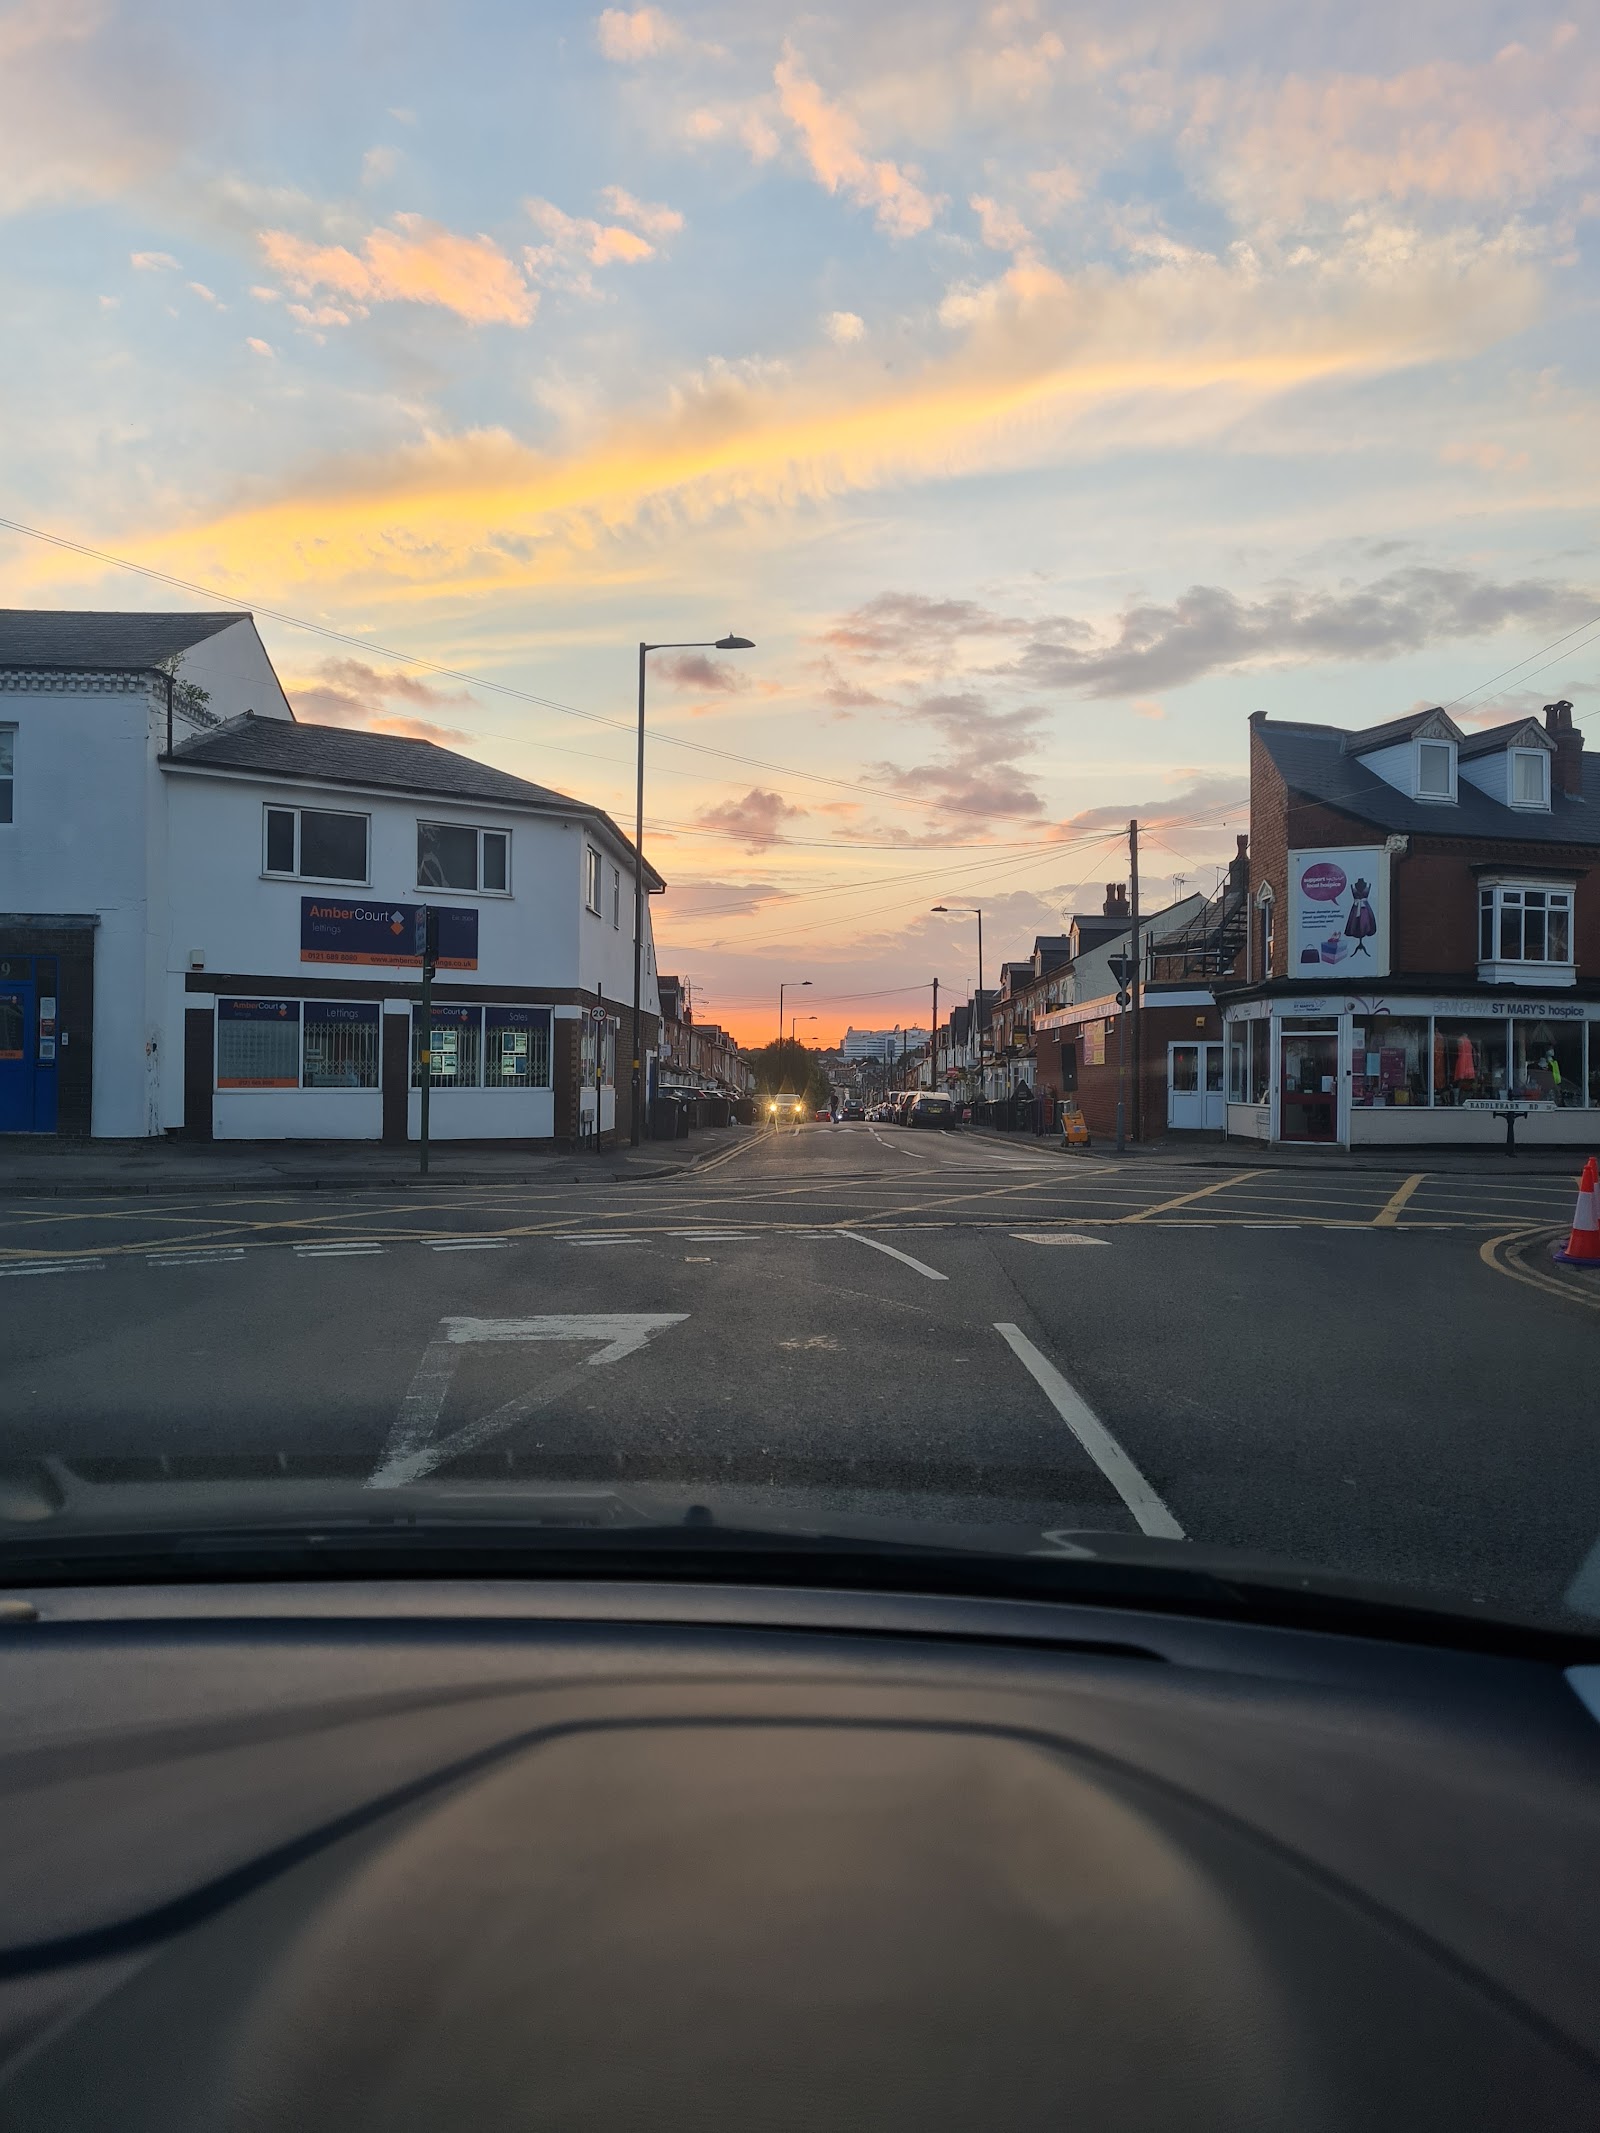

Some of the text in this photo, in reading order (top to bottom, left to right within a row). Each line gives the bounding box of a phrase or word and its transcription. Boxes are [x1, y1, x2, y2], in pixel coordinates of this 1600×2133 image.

[309, 905, 389, 923] AmberCourt
[312, 922, 341, 936] lettings
[307, 952, 324, 960] 0121
[233, 1001, 278, 1010] AmberCourt
[1492, 1003, 1504, 1014] ST
[1507, 1003, 1545, 1015] MARY'S
[1548, 1005, 1584, 1018] hospice
[326, 1008, 359, 1020] Lettings
[508, 1012, 528, 1022] Sales
[593, 1009, 605, 1017] 20
